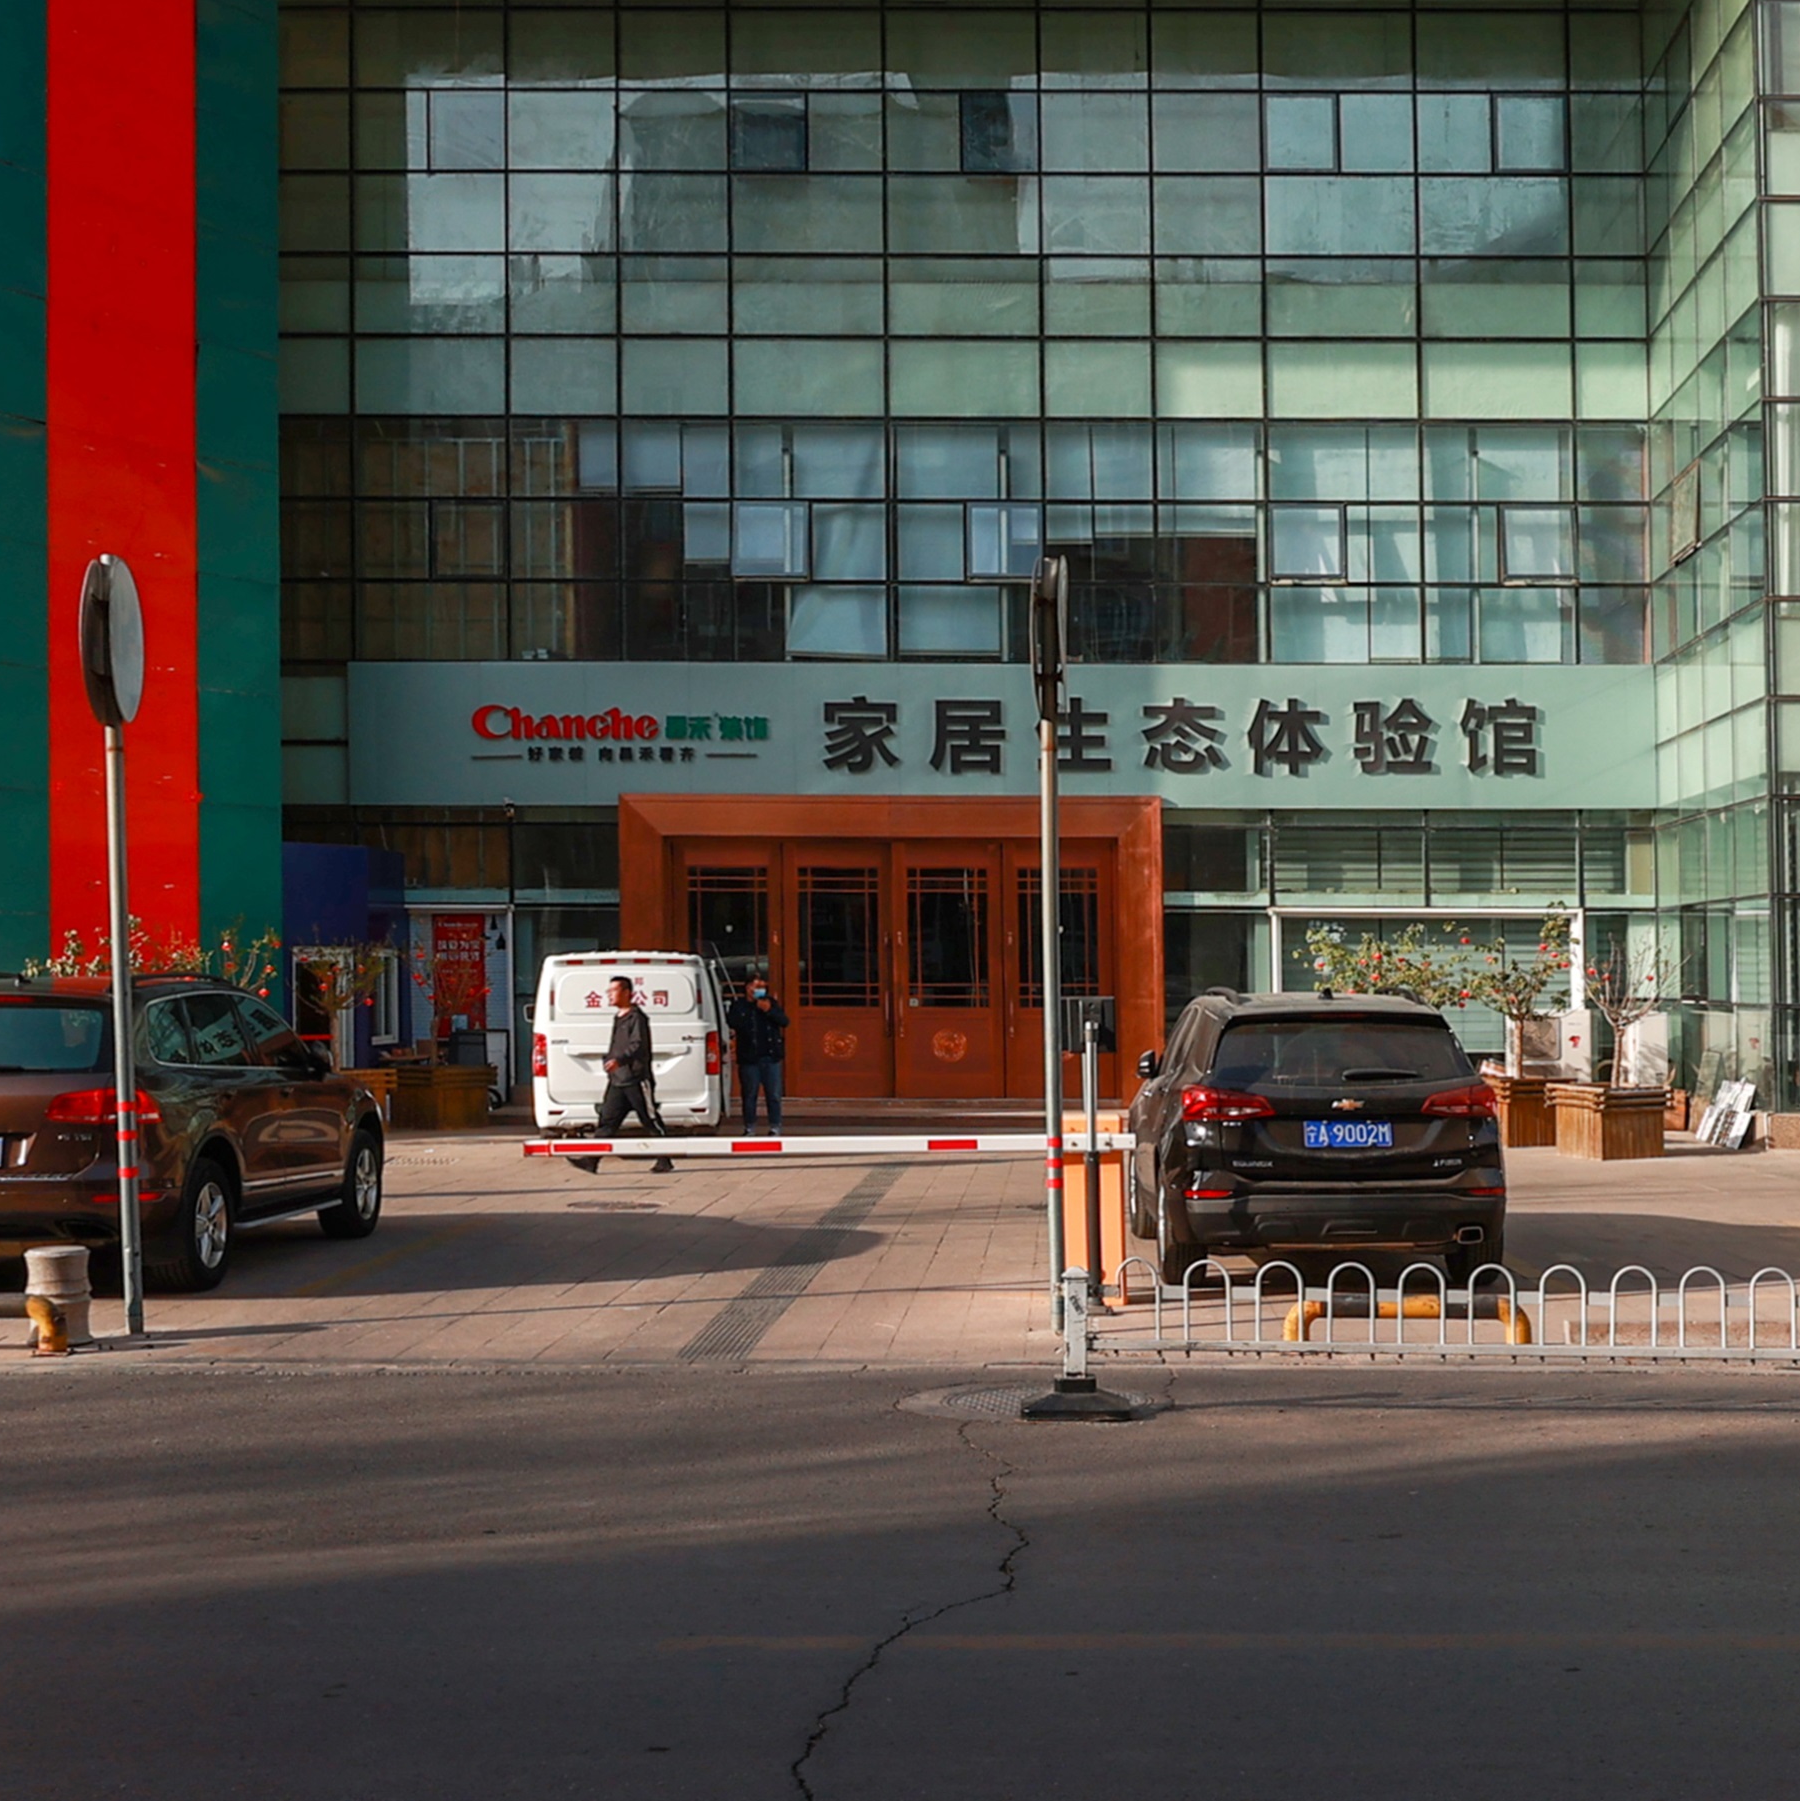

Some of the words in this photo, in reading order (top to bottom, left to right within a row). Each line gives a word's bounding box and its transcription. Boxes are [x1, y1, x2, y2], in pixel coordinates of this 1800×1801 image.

[822, 696, 1539, 776] 家居生态体验馆
[585, 990, 669, 1008] 金公司
